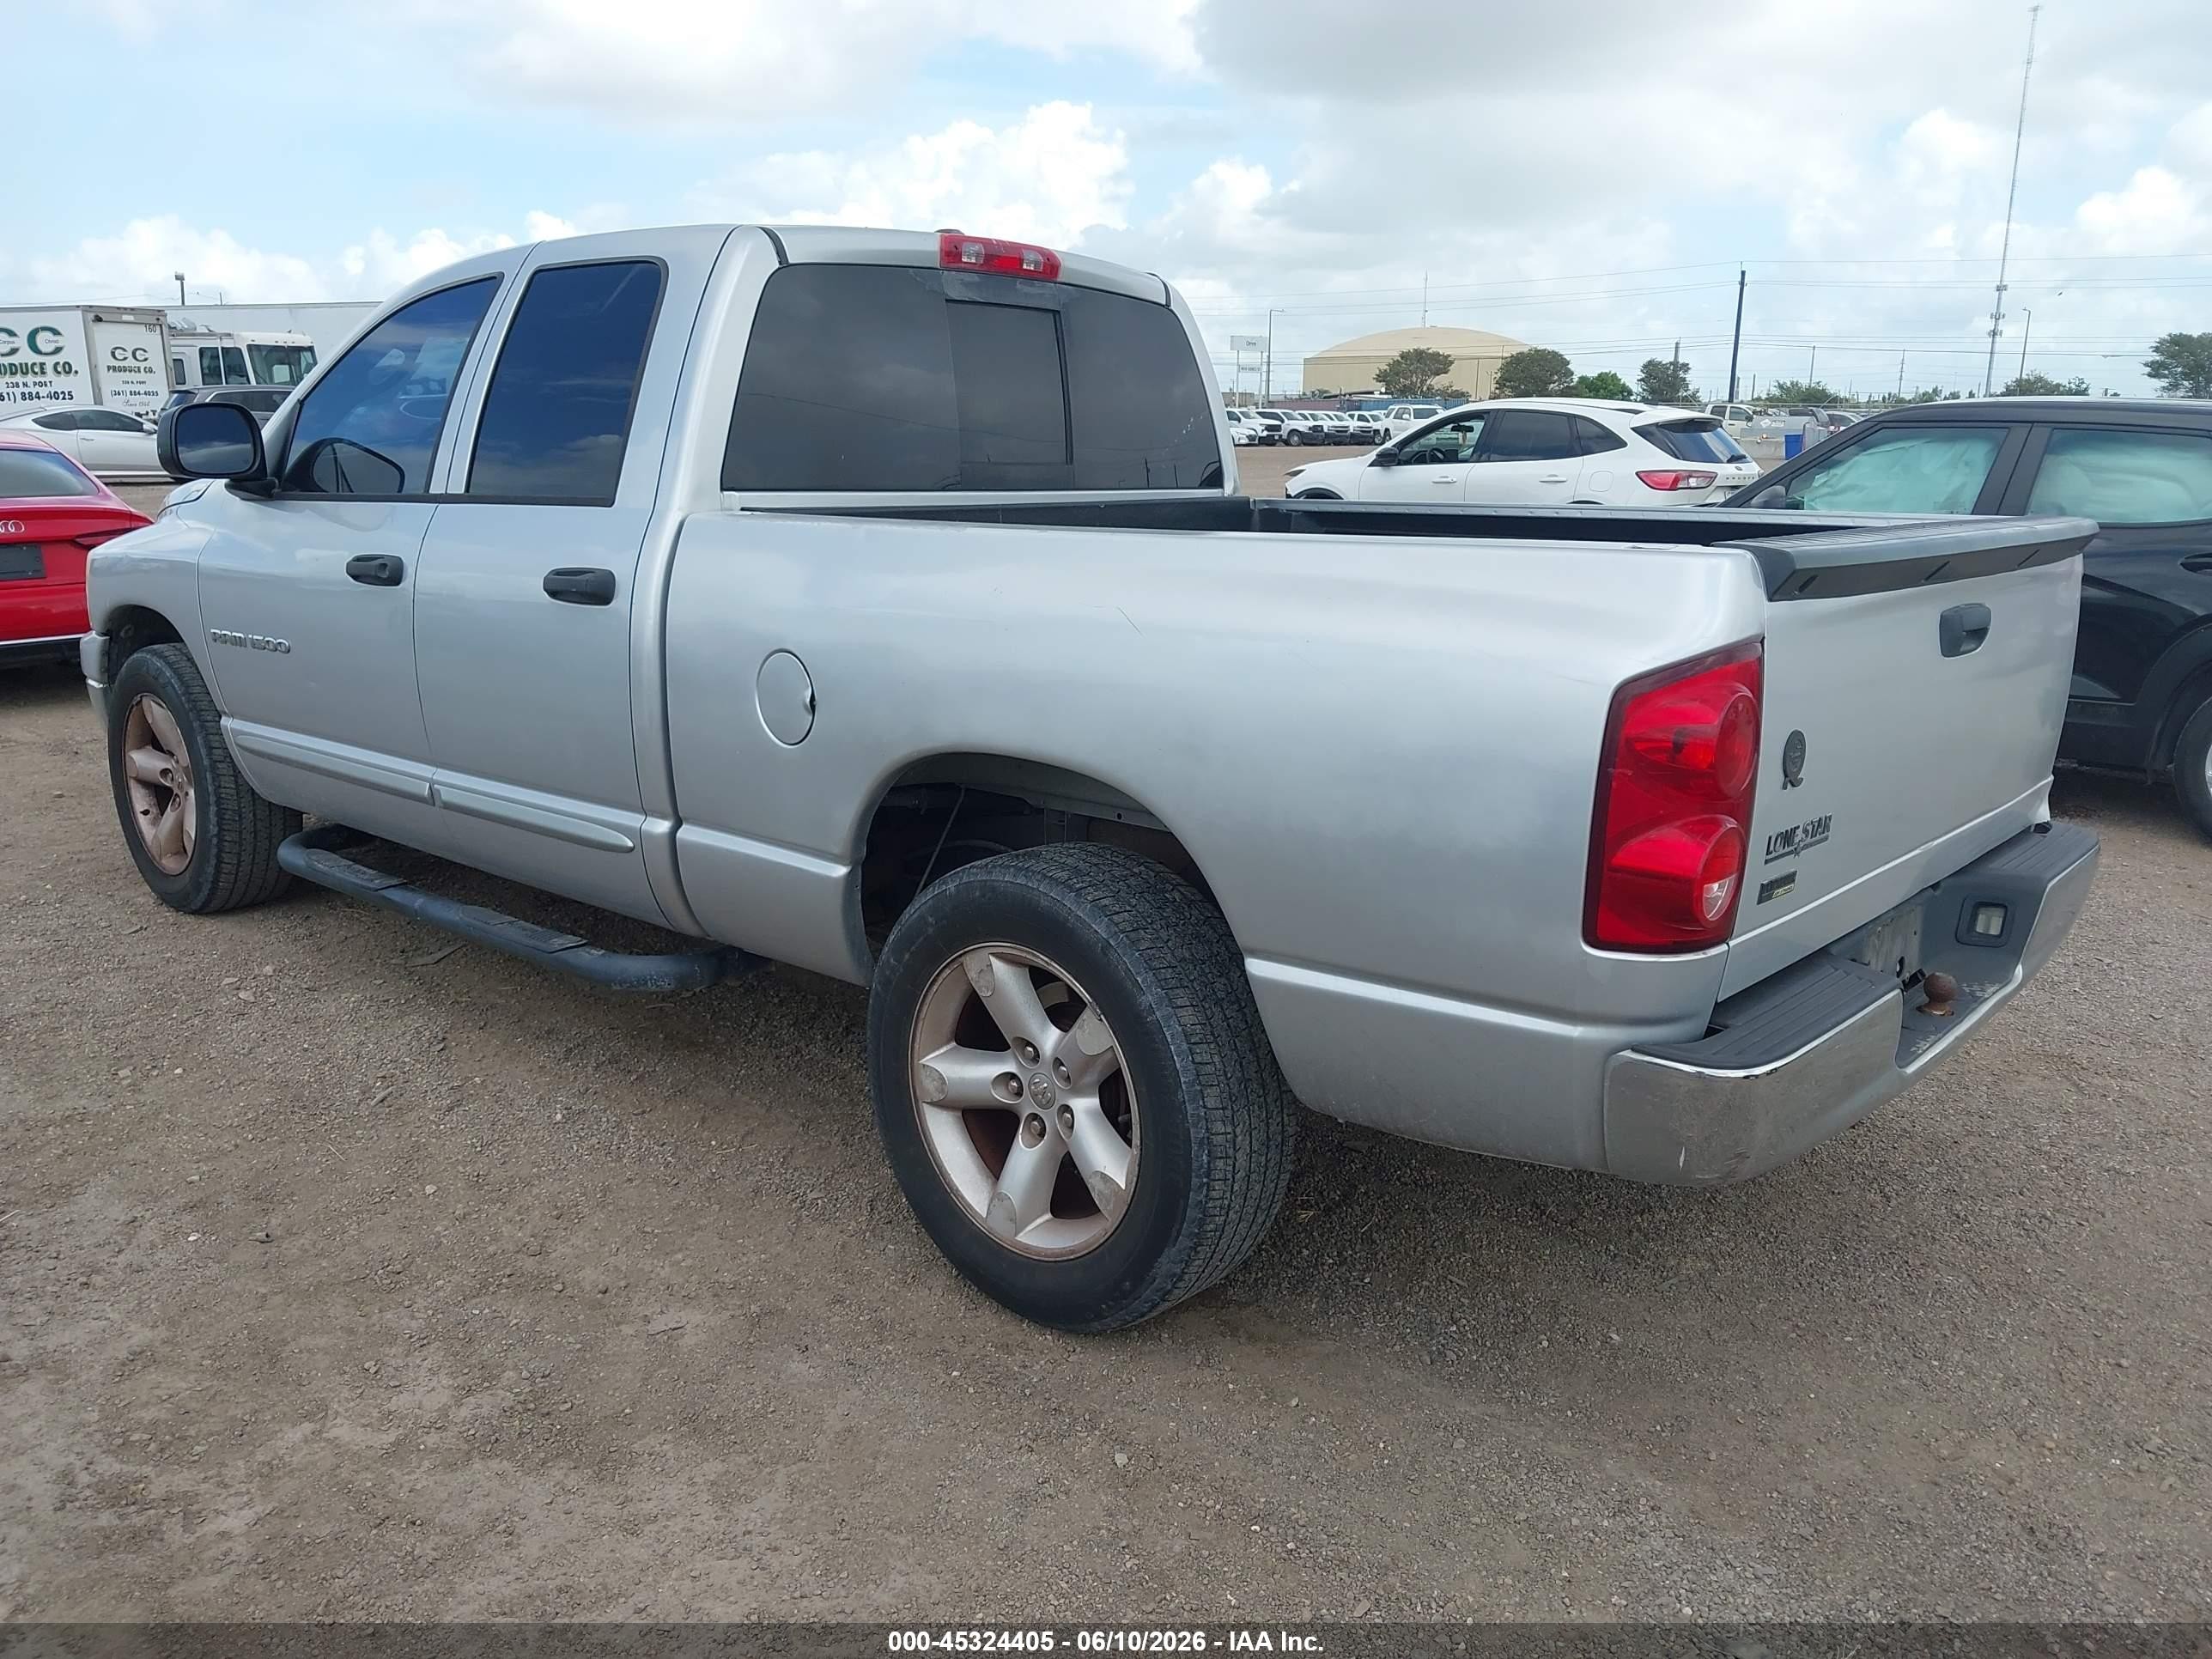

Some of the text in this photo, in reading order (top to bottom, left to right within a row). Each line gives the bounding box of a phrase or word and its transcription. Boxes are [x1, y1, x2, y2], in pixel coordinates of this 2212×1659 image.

[144, 324, 157, 333] 160
[53, 361, 79, 375] CO.
[106, 365, 142, 374] PRODUCE
[5, 380, 21, 389] 238
[20, 390, 74, 402] 884-4025
[210, 629, 291, 654] RAM 1500
[1765, 812, 1832, 856] LONE STAR
